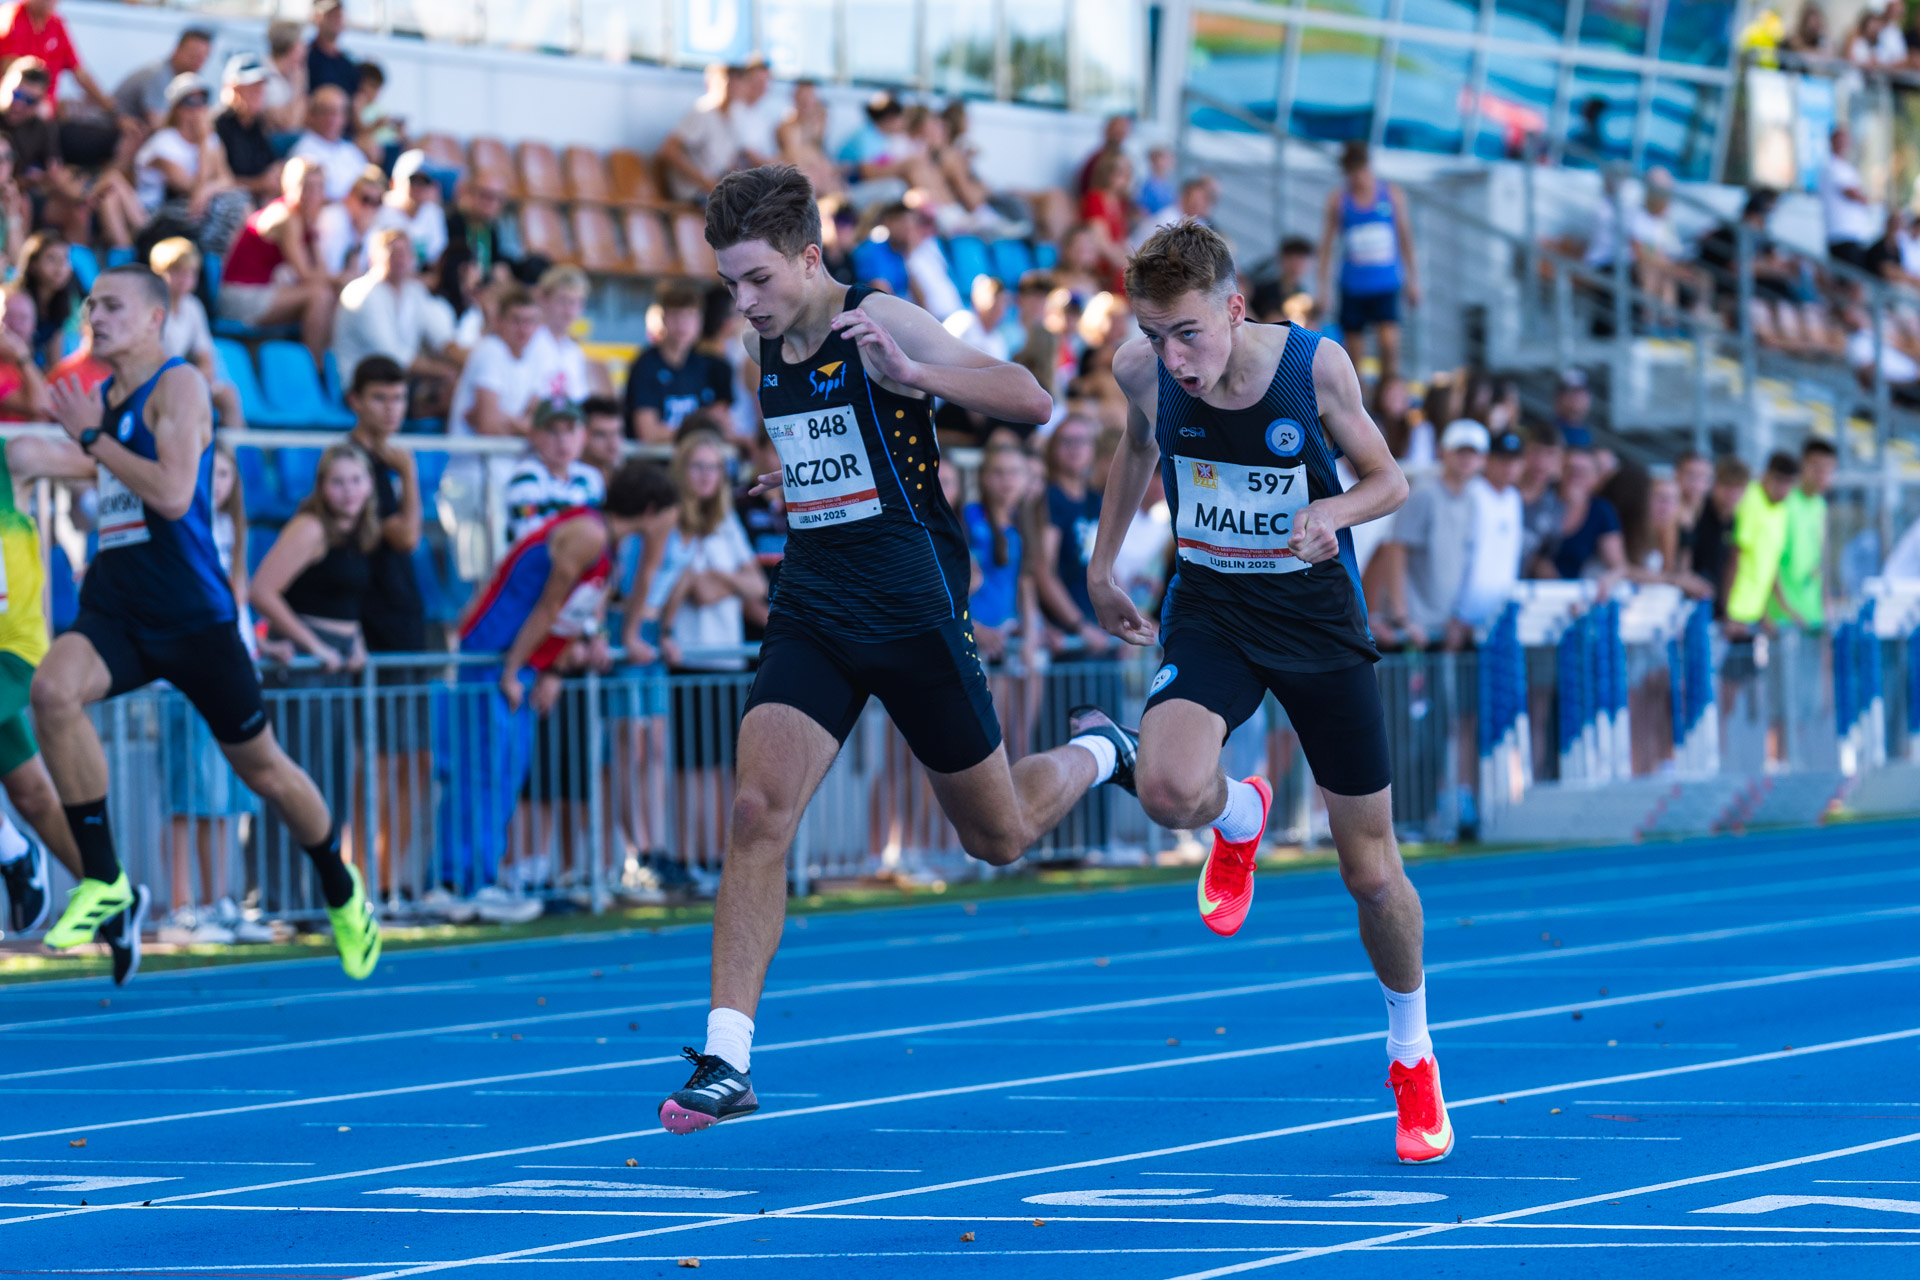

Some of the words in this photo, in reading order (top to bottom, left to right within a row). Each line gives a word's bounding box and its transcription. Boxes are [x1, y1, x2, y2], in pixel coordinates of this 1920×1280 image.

[809, 362, 847, 401] Sopot
[807, 414, 847, 440] 848
[1179, 426, 1206, 437] esa
[783, 453, 862, 488] ACZOR
[1247, 472, 1295, 495] 597
[799, 513, 822, 524] LUBLIN
[823, 509, 847, 520] 2025
[1194, 502, 1289, 536] MALEC
[1210, 557, 1245, 568] LUBLIN
[1021, 1188, 1449, 1208] 3
